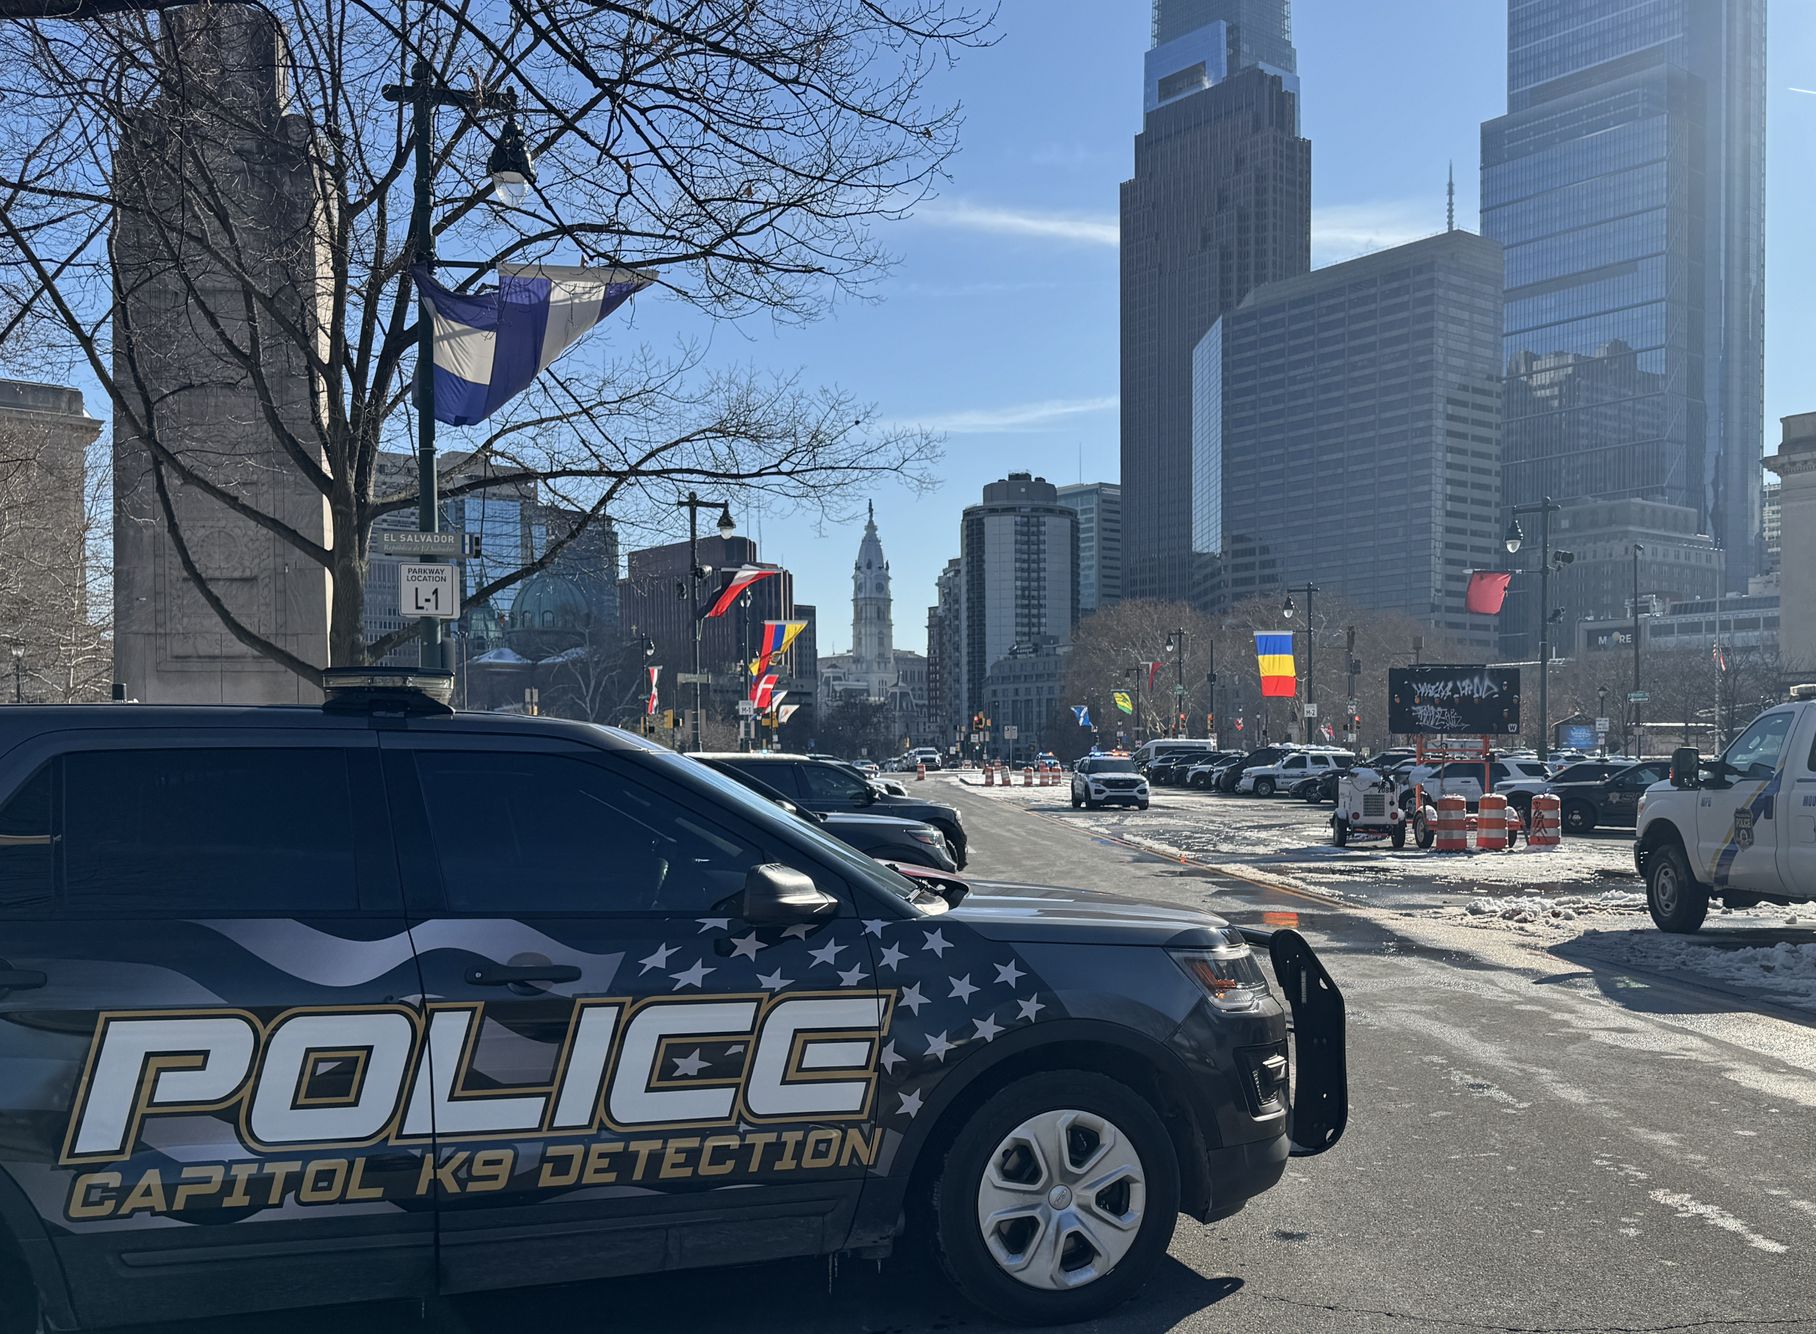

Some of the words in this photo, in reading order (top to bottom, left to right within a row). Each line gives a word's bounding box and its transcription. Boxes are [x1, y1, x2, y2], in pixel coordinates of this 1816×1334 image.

[384, 533, 396, 542] EL
[400, 534, 455, 544] SALVADOR
[406, 575, 447, 583] LOCATION
[407, 567, 445, 575] PARKWAY
[415, 587, 439, 611] L-1
[58, 989, 896, 1165] POLICE
[69, 1157, 384, 1218] CAPITOL
[415, 1148, 514, 1195] K9
[538, 1128, 882, 1187] DETECTION
